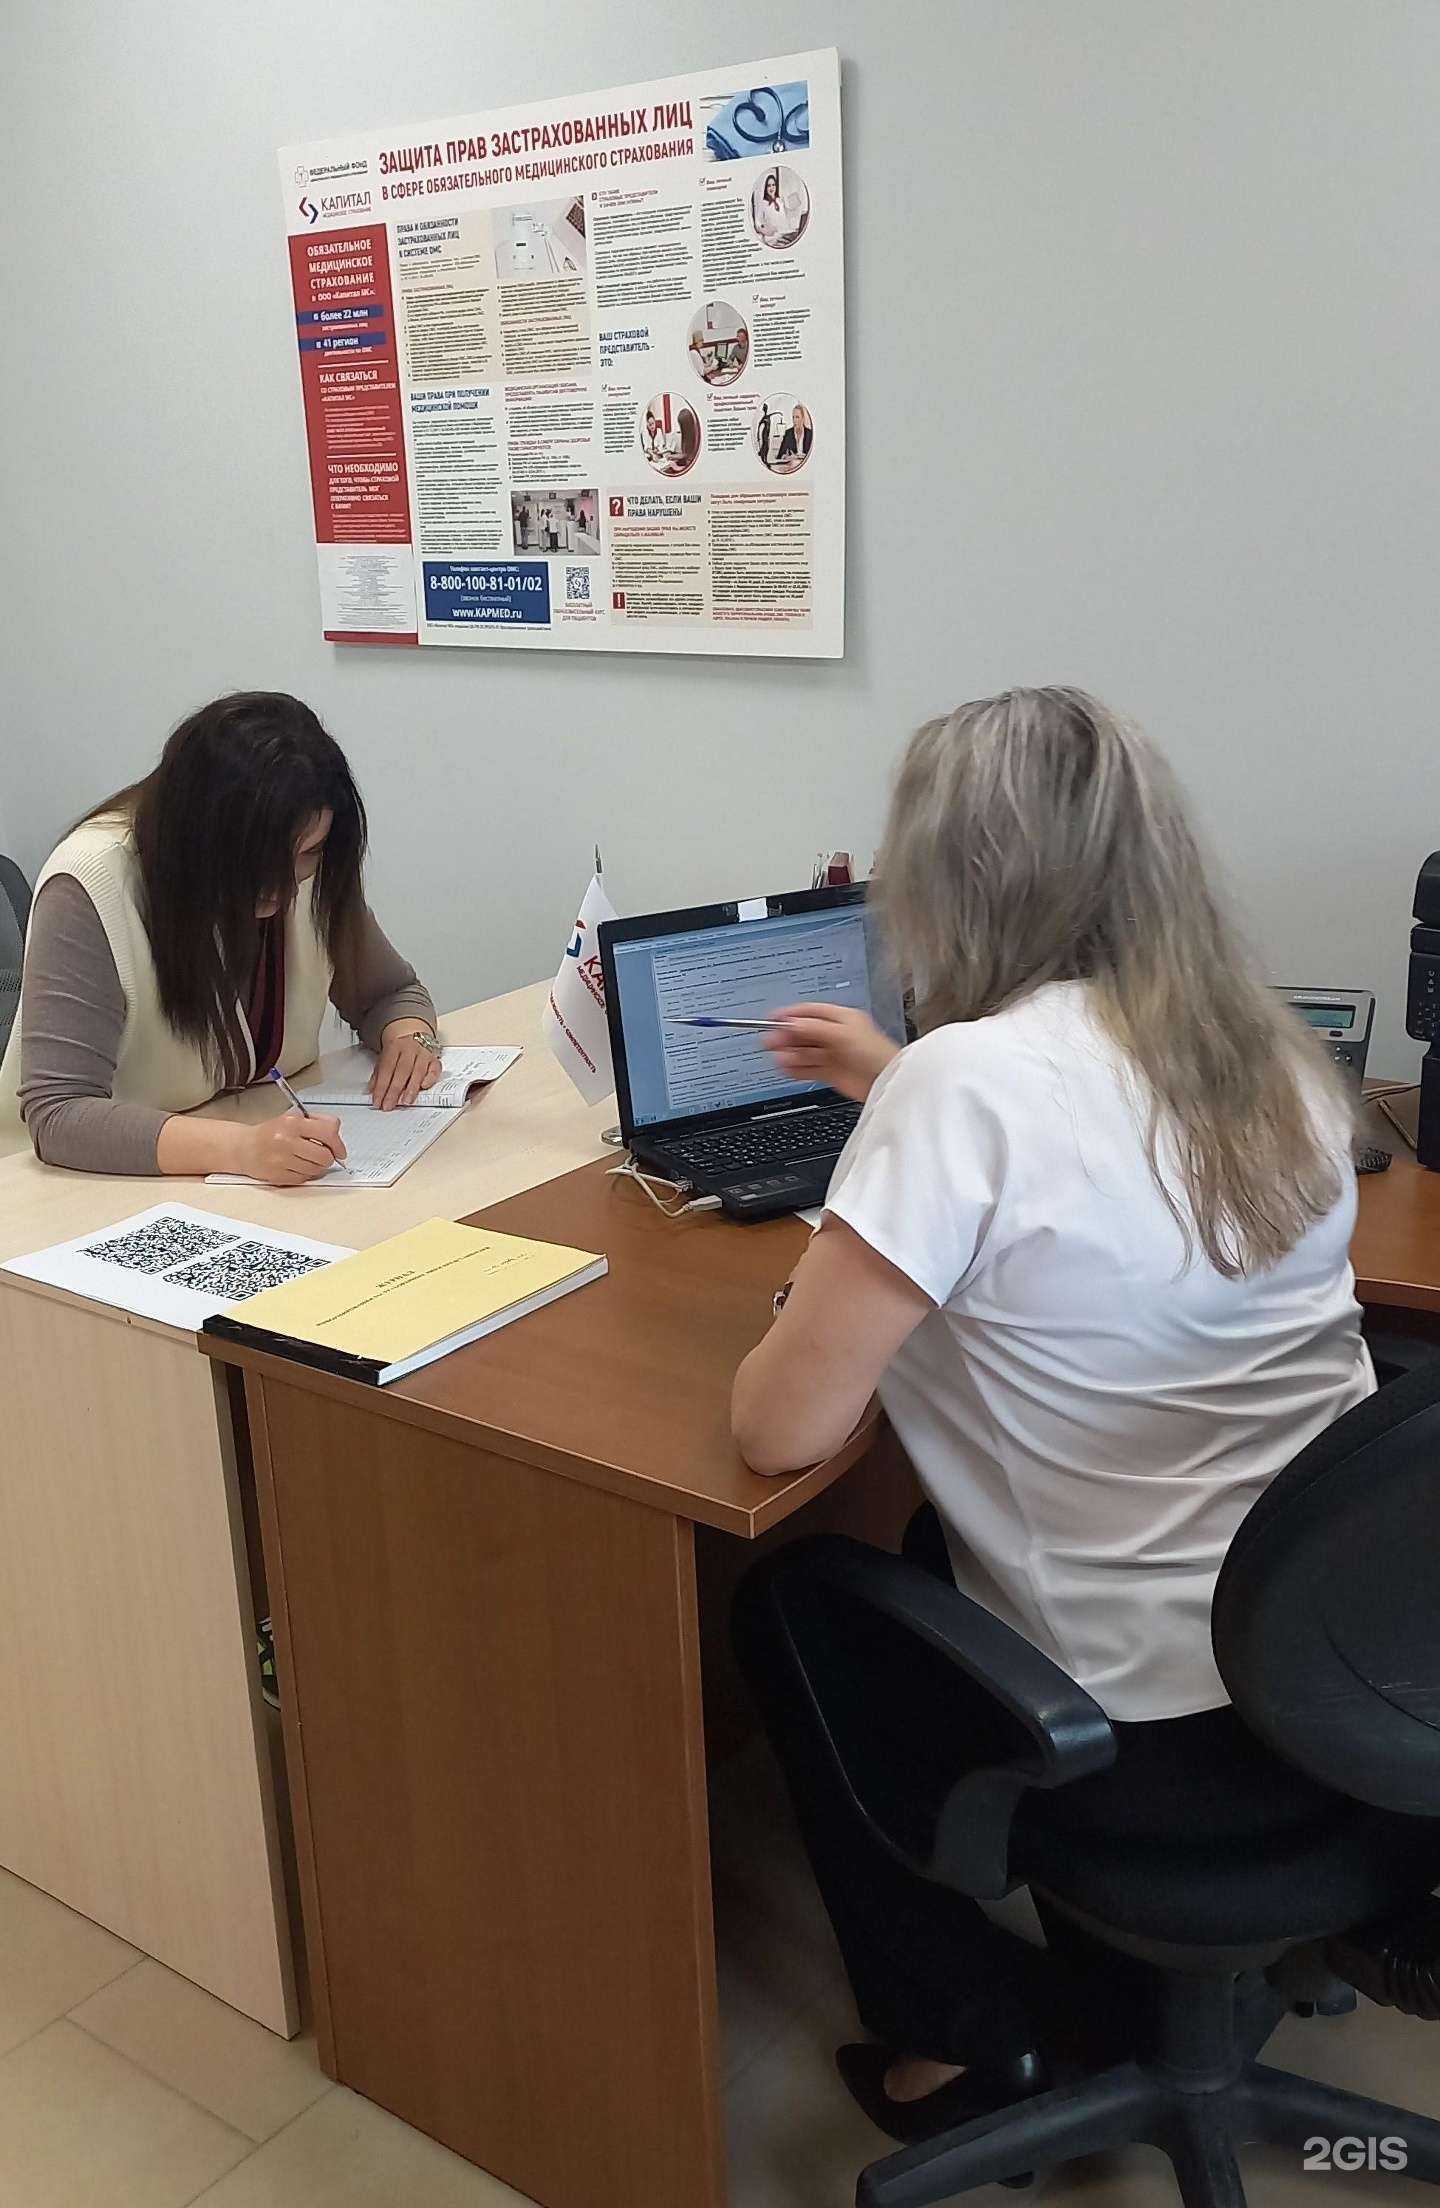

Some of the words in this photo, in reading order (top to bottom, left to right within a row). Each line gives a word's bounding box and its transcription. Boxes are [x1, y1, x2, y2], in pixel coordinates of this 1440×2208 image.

[379, 144, 443, 175] ЗАЩИТА
[446, 136, 487, 164] ПРАВ
[491, 108, 648, 157] ЗАСТРАХОВАННЫХ
[652, 101, 693, 130] ЛИЦ
[382, 186, 388, 200] В
[390, 180, 424, 199] СФЕРЕ
[427, 166, 512, 194] ОБЯЗАТЕЛЬНОГО
[515, 152, 607, 181] МЕДИЦИНСКОГО
[610, 138, 694, 167] СТРАХОВАНИЯ
[321, 191, 371, 211] КАПИТАЛ
[397, 224, 413, 233] ПРАВА
[420, 218, 459, 231] ОБЯЗАННОСТИ
[397, 231, 446, 246] ЗАСТРАХОВАННЫХ
[447, 231, 460, 240] ЛИЦ
[307, 239, 372, 257] ОБЯЗАТЕЛЬНОЕ
[404, 247, 428, 257] СИСТЕМЕ
[430, 245, 442, 254] ОМС
[308, 256, 373, 274] МЕДИЦИНСКОЕ
[310, 272, 374, 289] СТРАХОВАНИЕ
[317, 293, 331, 301] ООО
[320, 311, 342, 322] более
[343, 309, 352, 319] 22
[353, 309, 368, 317] млн
[599, 332, 613, 341] ВАШ
[614, 327, 649, 340] СТРАХОВОЙ
[323, 339, 332, 348] 41
[332, 337, 359, 349] регион
[600, 342, 650, 354] ПРЕДСТАВИТЕЛЬ
[600, 359, 613, 367] ЭТО:
[319, 373, 335, 383] КАК
[336, 370, 378, 381] СВЯЗАТЬСЯ
[327, 464, 343, 474] ЧТО
[344, 462, 398, 475] НЕОБХОДИМО
[627, 496, 639, 505] ЧТО
[640, 496, 664, 505] ДЕЛАТЬ,
[665, 495, 681, 504] ЕСЛИ
[683, 495, 702, 503] ВАШИ
[627, 508, 646, 517] ПРАВА
[647, 508, 683, 517] НАРУШЕНЫ
[430, 576, 542, 591] 8-800-100-81-01/02
[452, 607, 522, 619] www.KAPMED.ru
[583, 955, 605, 991] КА
